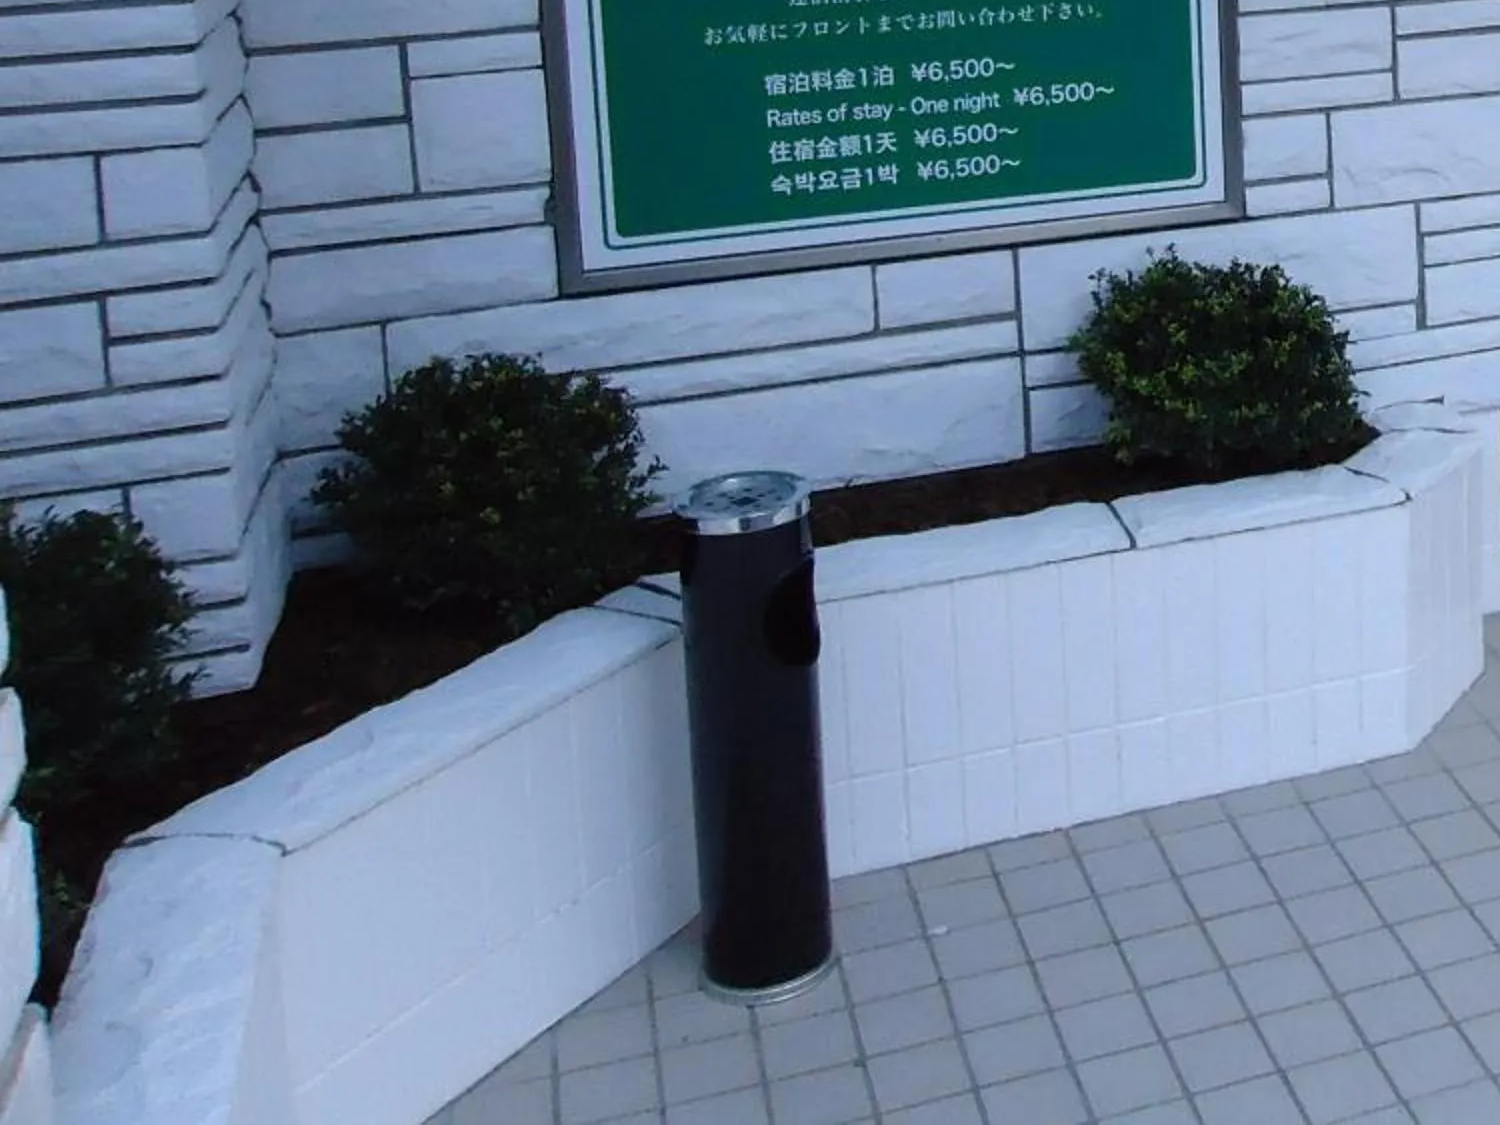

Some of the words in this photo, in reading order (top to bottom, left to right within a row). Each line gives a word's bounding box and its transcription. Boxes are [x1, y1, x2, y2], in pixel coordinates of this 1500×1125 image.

[765, 66, 894, 95] 宿泊料金1泊
[767, 109, 822, 127] Rates
[827, 103, 847, 122] of
[853, 103, 893, 121] stay
[911, 96, 949, 115] One
[954, 92, 1000, 113] night
[772, 164, 899, 195] 숙박요금1박
